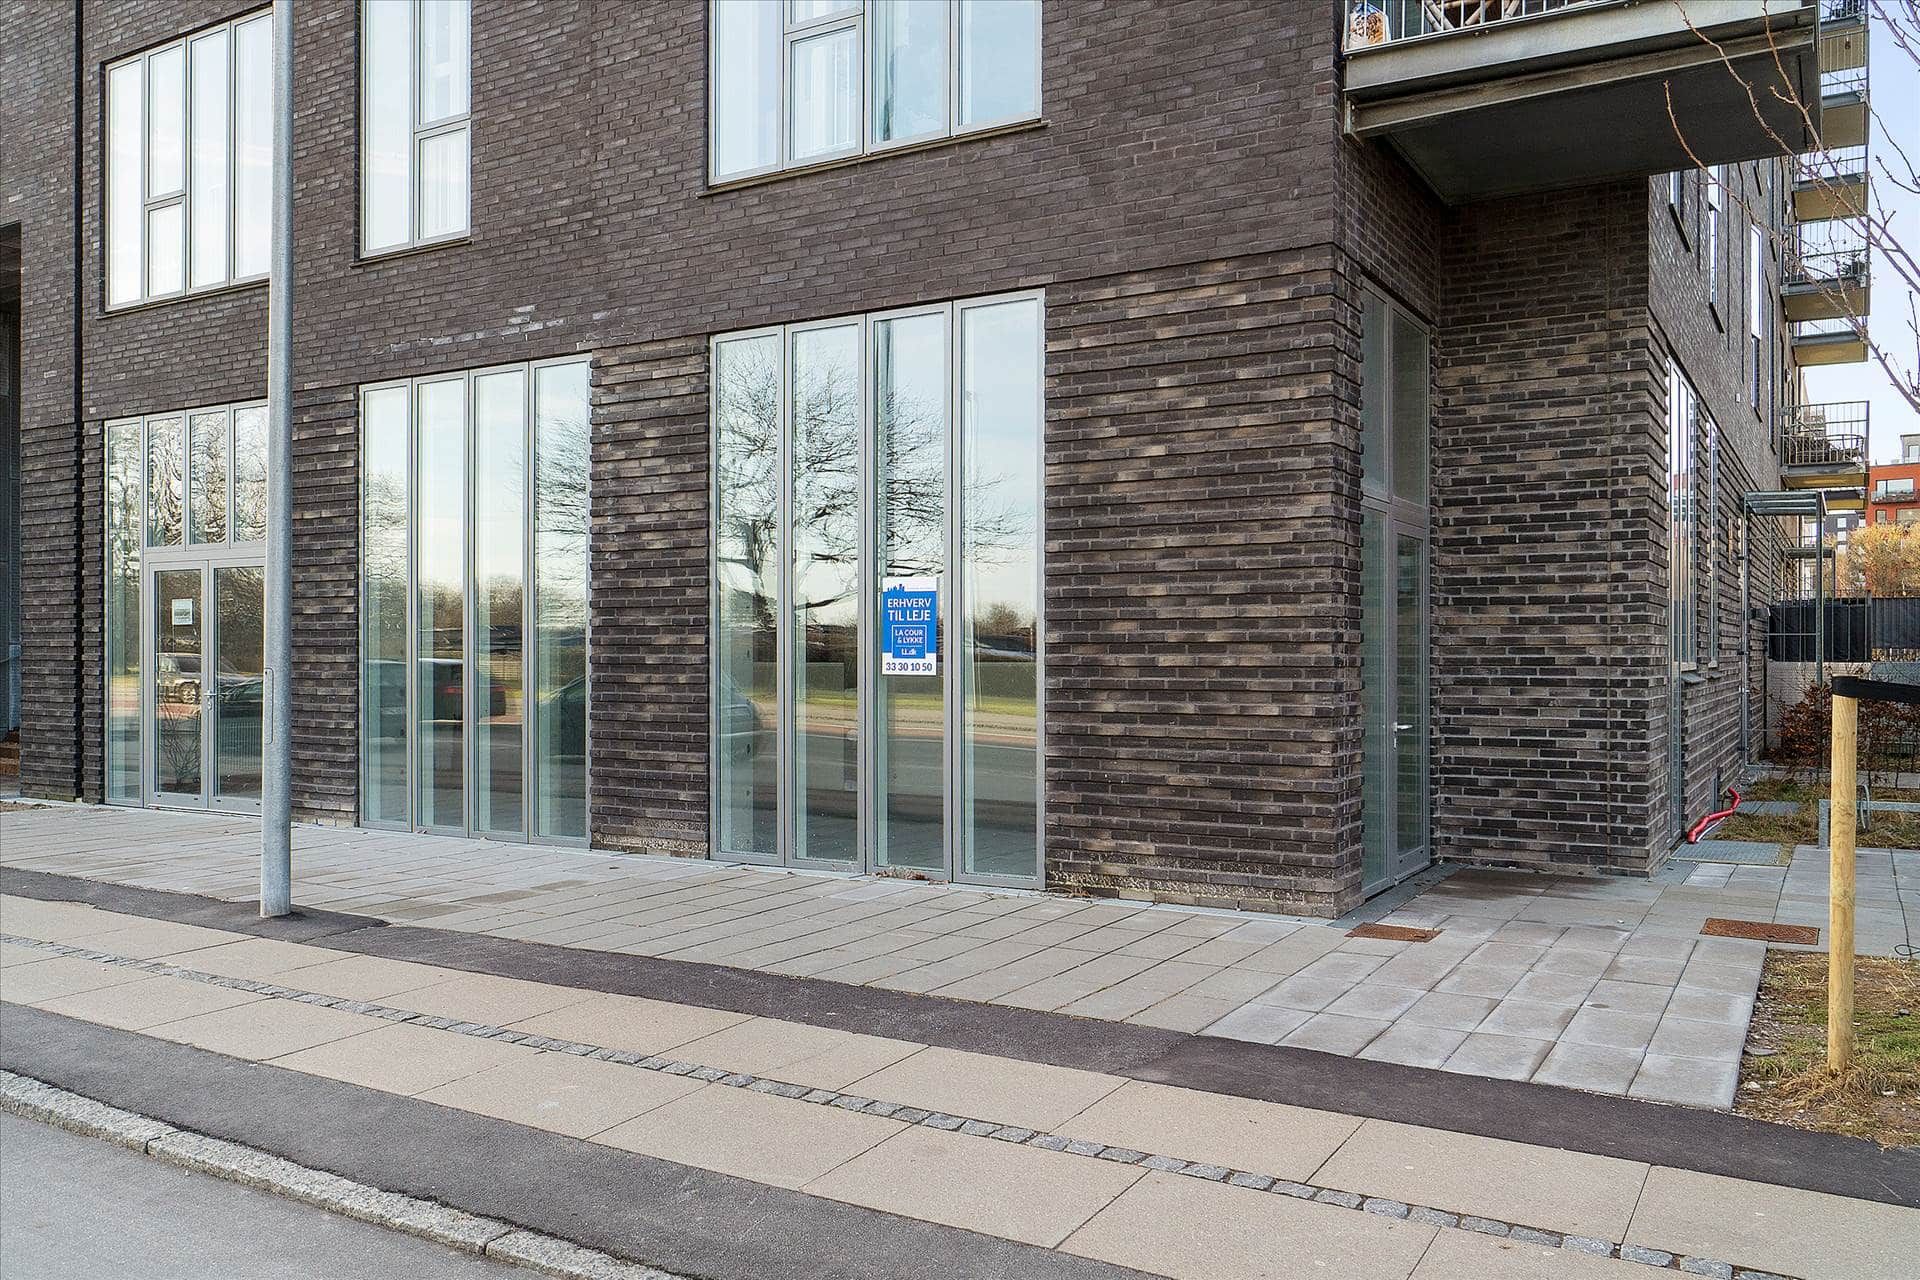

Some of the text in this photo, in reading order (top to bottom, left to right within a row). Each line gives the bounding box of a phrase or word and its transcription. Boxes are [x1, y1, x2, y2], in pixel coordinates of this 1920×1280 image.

[887, 598, 932, 608] ERHVERV
[888, 610, 931, 621] TIL LEJE
[886, 662, 933, 671] 33 30 10 50
